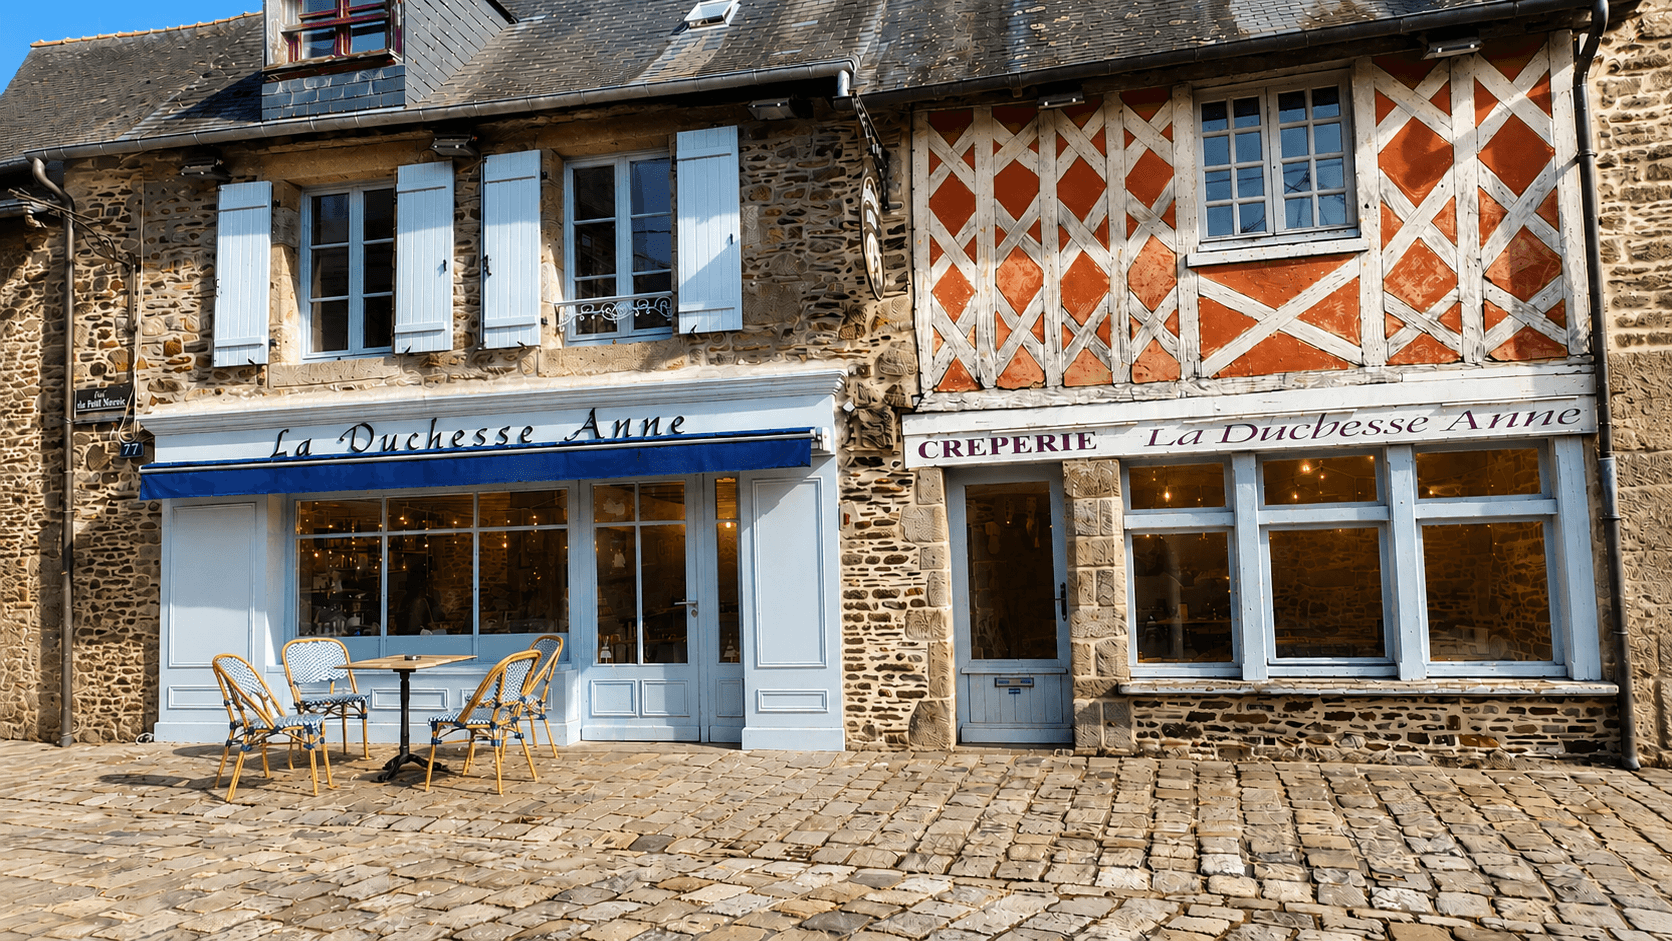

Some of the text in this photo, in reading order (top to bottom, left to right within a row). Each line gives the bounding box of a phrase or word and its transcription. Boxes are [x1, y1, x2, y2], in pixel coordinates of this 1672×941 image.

[123, 443, 139, 455] 77
[270, 407, 685, 458] La Duchesse Anne
[917, 407, 1583, 460] CREPERIE La Duchesse Anne
